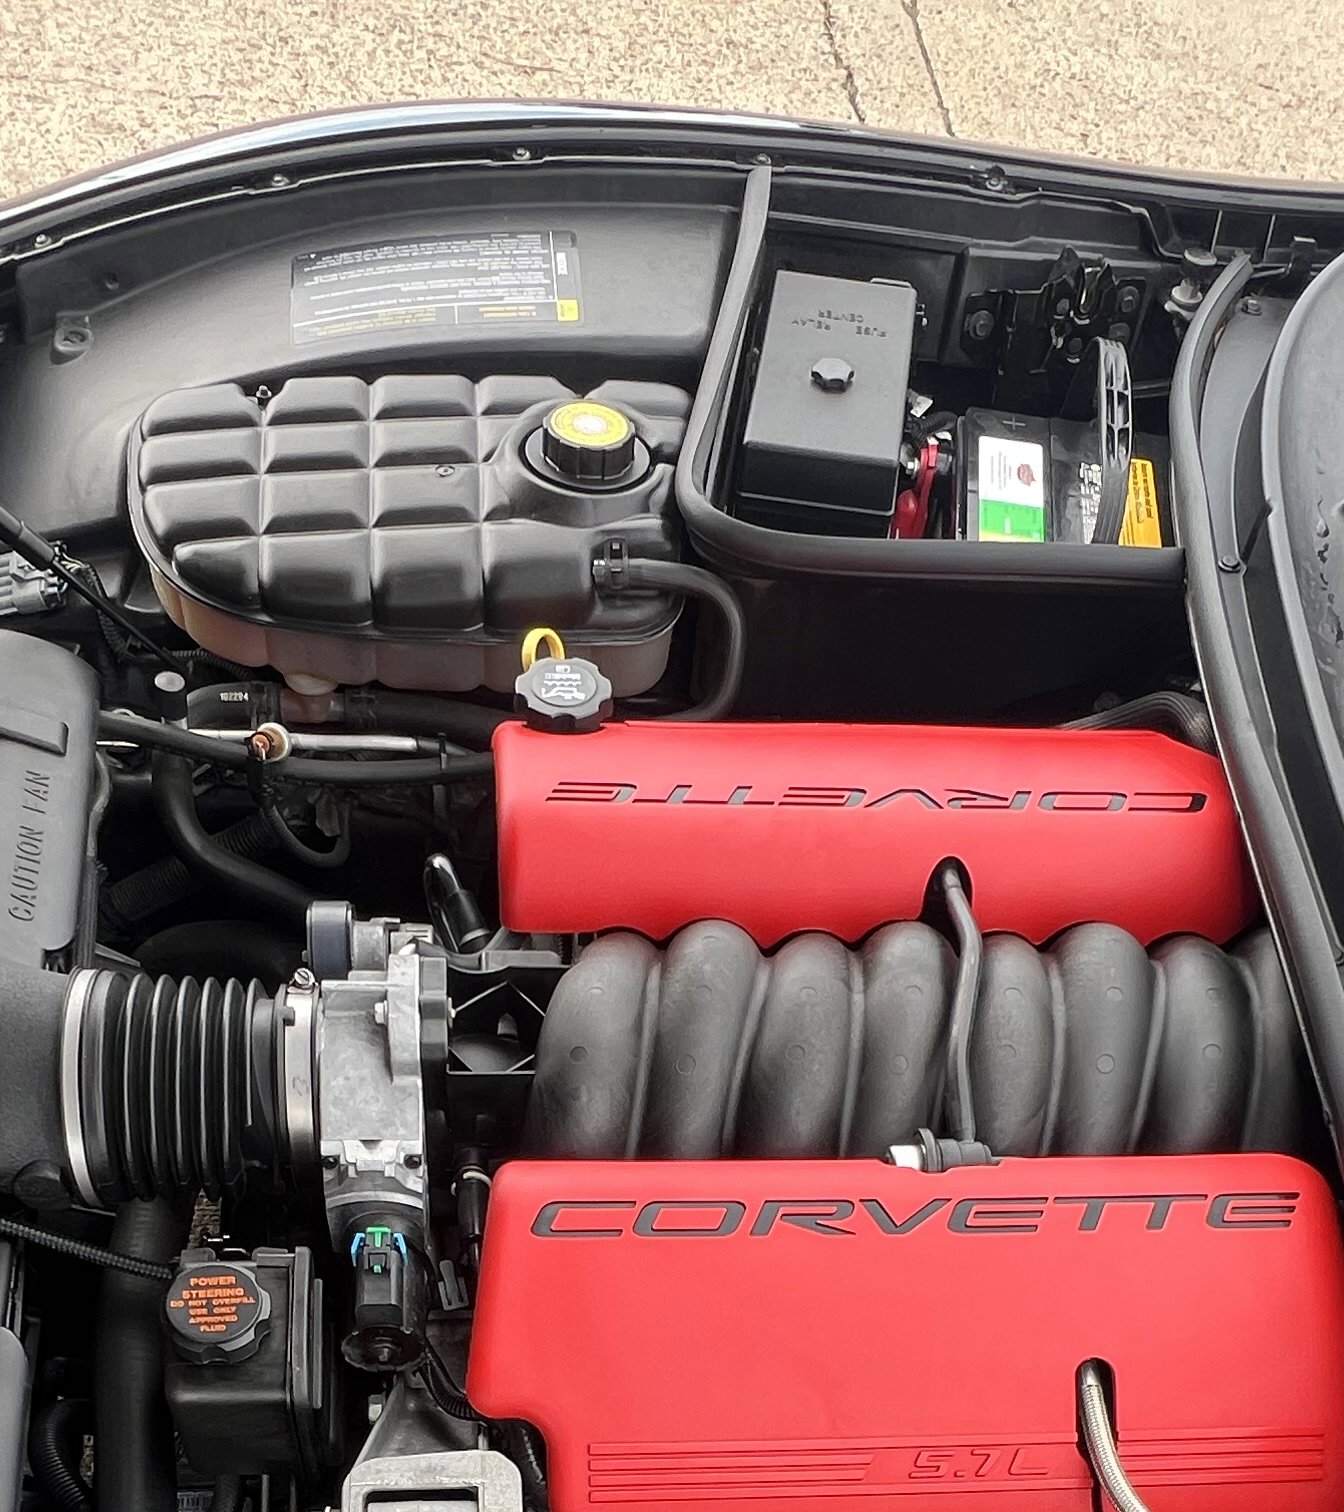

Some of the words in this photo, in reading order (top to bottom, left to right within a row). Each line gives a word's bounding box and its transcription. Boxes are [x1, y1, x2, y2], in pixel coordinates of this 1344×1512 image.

[21, 770, 50, 814] FAN
[545, 780, 1208, 814] CORVETTE
[8, 825, 44, 922] CAUTION
[529, 1191, 1300, 1240] CORVETTE
[189, 1276, 236, 1287] POWER
[182, 1287, 245, 1299] STEERING
[170, 1300, 185, 1308] DO
[212, 1296, 256, 1305] OVERFILL
[213, 1306, 237, 1314] ONLY
[188, 1315, 238, 1324] APPROVED
[200, 1324, 227, 1332] FLUID
[907, 1446, 1052, 1481] 5.7L
